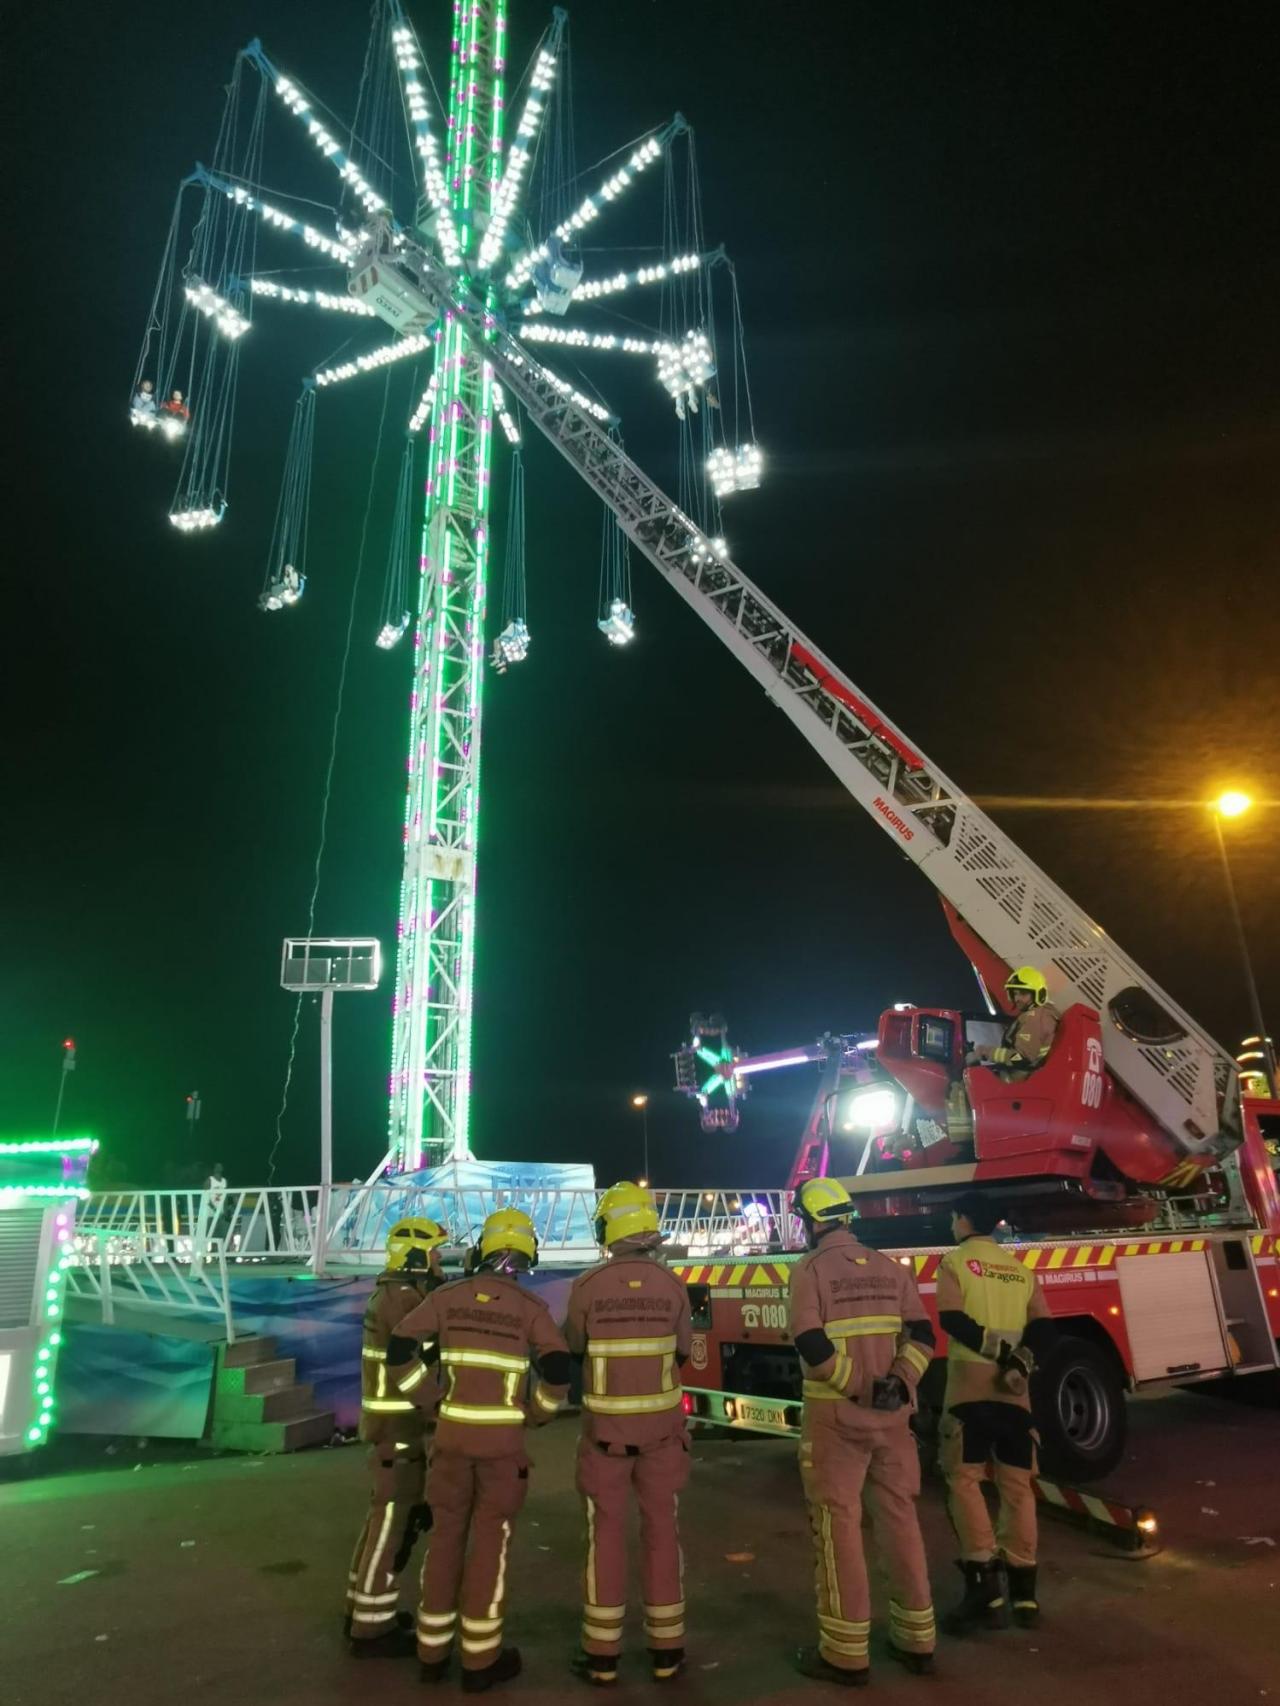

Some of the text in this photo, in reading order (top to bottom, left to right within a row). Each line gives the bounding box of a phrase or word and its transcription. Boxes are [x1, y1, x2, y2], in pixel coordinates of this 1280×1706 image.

[873, 797, 914, 840] MAGIRUS
[1081, 1071, 1102, 1109] 080
[984, 1269, 1025, 1283] Zaragoza
[1045, 1272, 1083, 1285] MAGIRUS
[745, 1288, 780, 1299] MAGIRUS
[761, 1304, 787, 1328] 080
[745, 1406, 765, 1421] 7320
